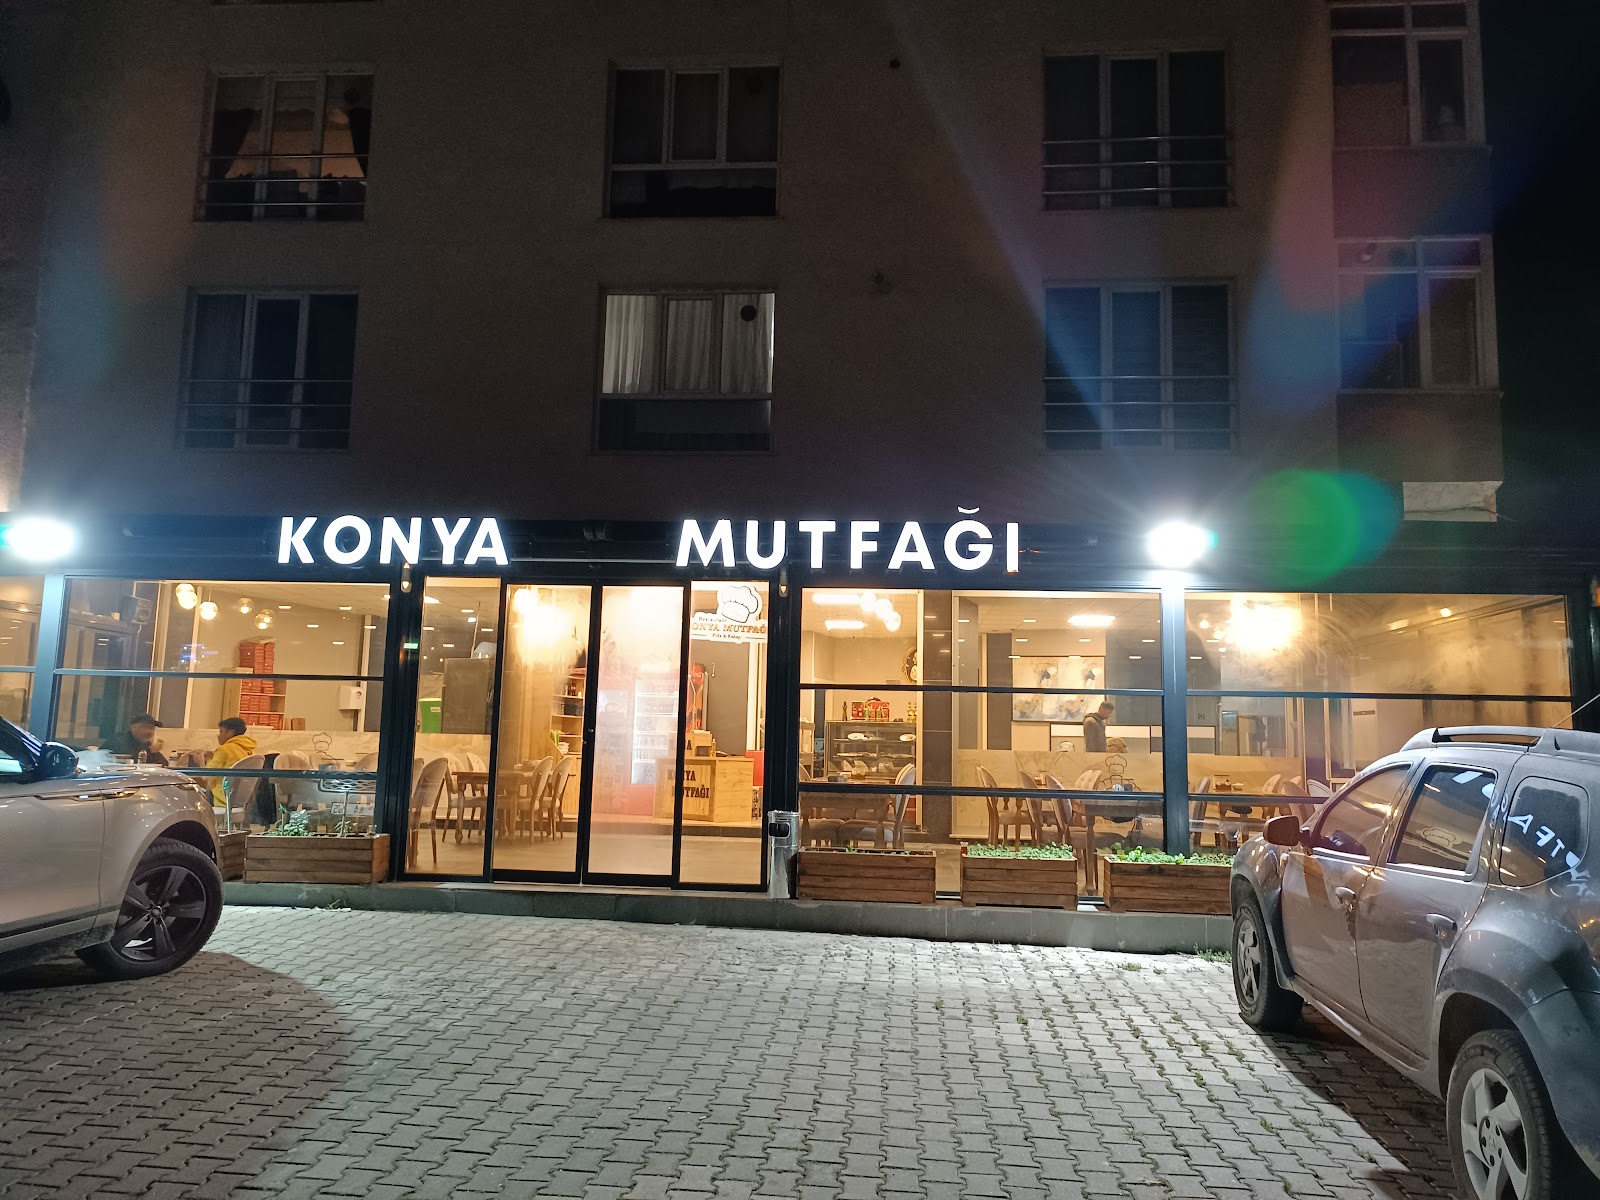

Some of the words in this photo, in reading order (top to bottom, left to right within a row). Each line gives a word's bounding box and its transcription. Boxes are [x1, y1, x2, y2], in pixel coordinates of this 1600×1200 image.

[278, 514, 509, 565] KONYA
[675, 506, 1019, 573] MUTFAĞI
[692, 622, 720, 632] ONYA
